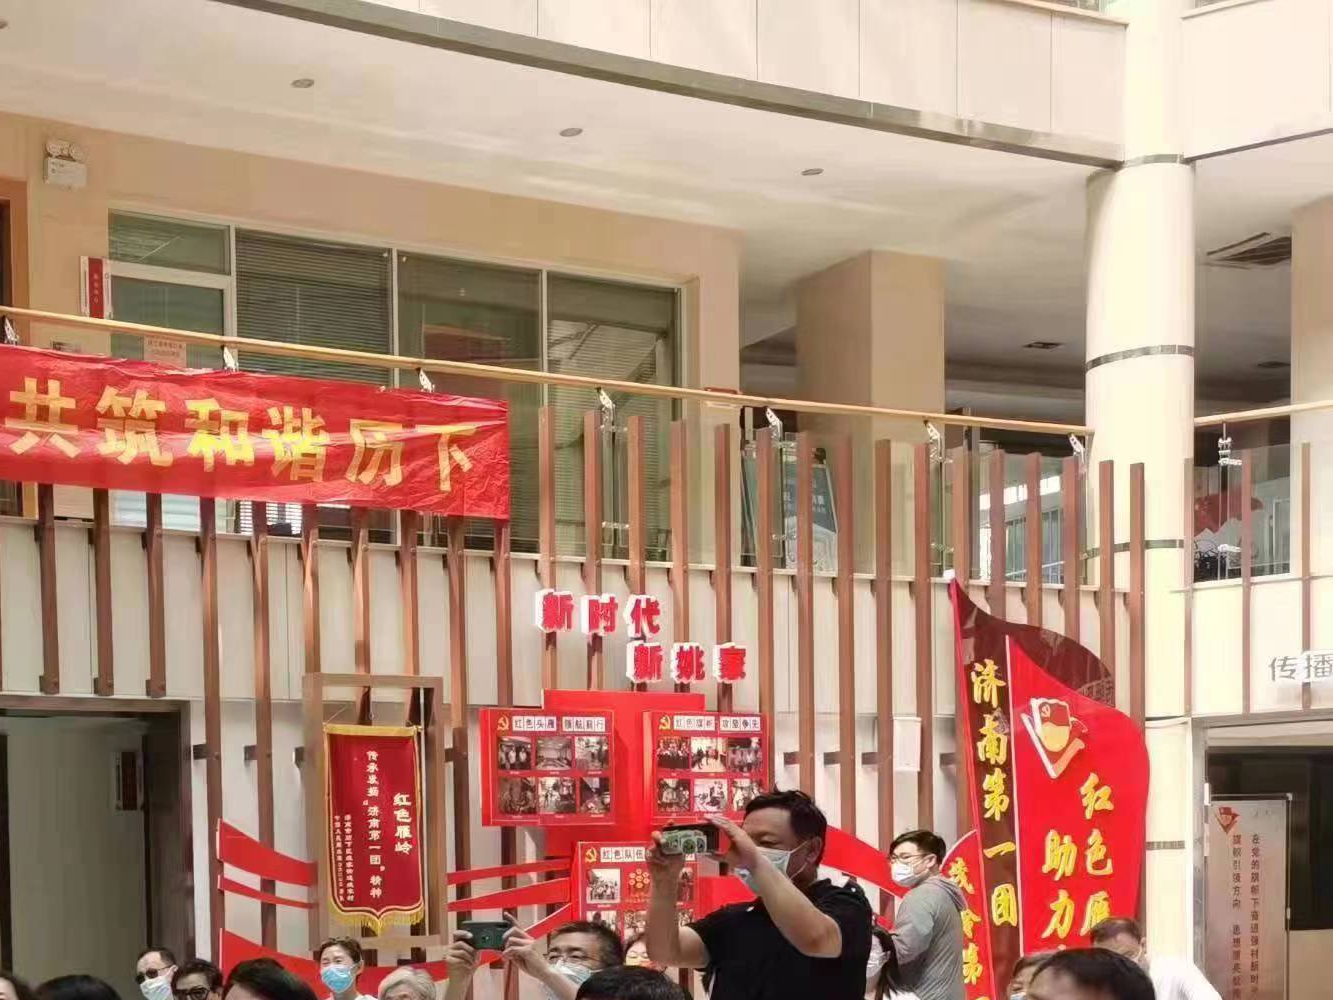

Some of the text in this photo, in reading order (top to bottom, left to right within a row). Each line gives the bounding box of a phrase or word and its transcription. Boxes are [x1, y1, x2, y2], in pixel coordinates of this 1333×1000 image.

[6, 377, 475, 491] 共筑和谐历下
[539, 590, 662, 636] 新时代
[1268, 654, 1333, 681] 传播
[970, 658, 1018, 927] 济南第一团
[393, 793, 413, 855] 红色雁岭
